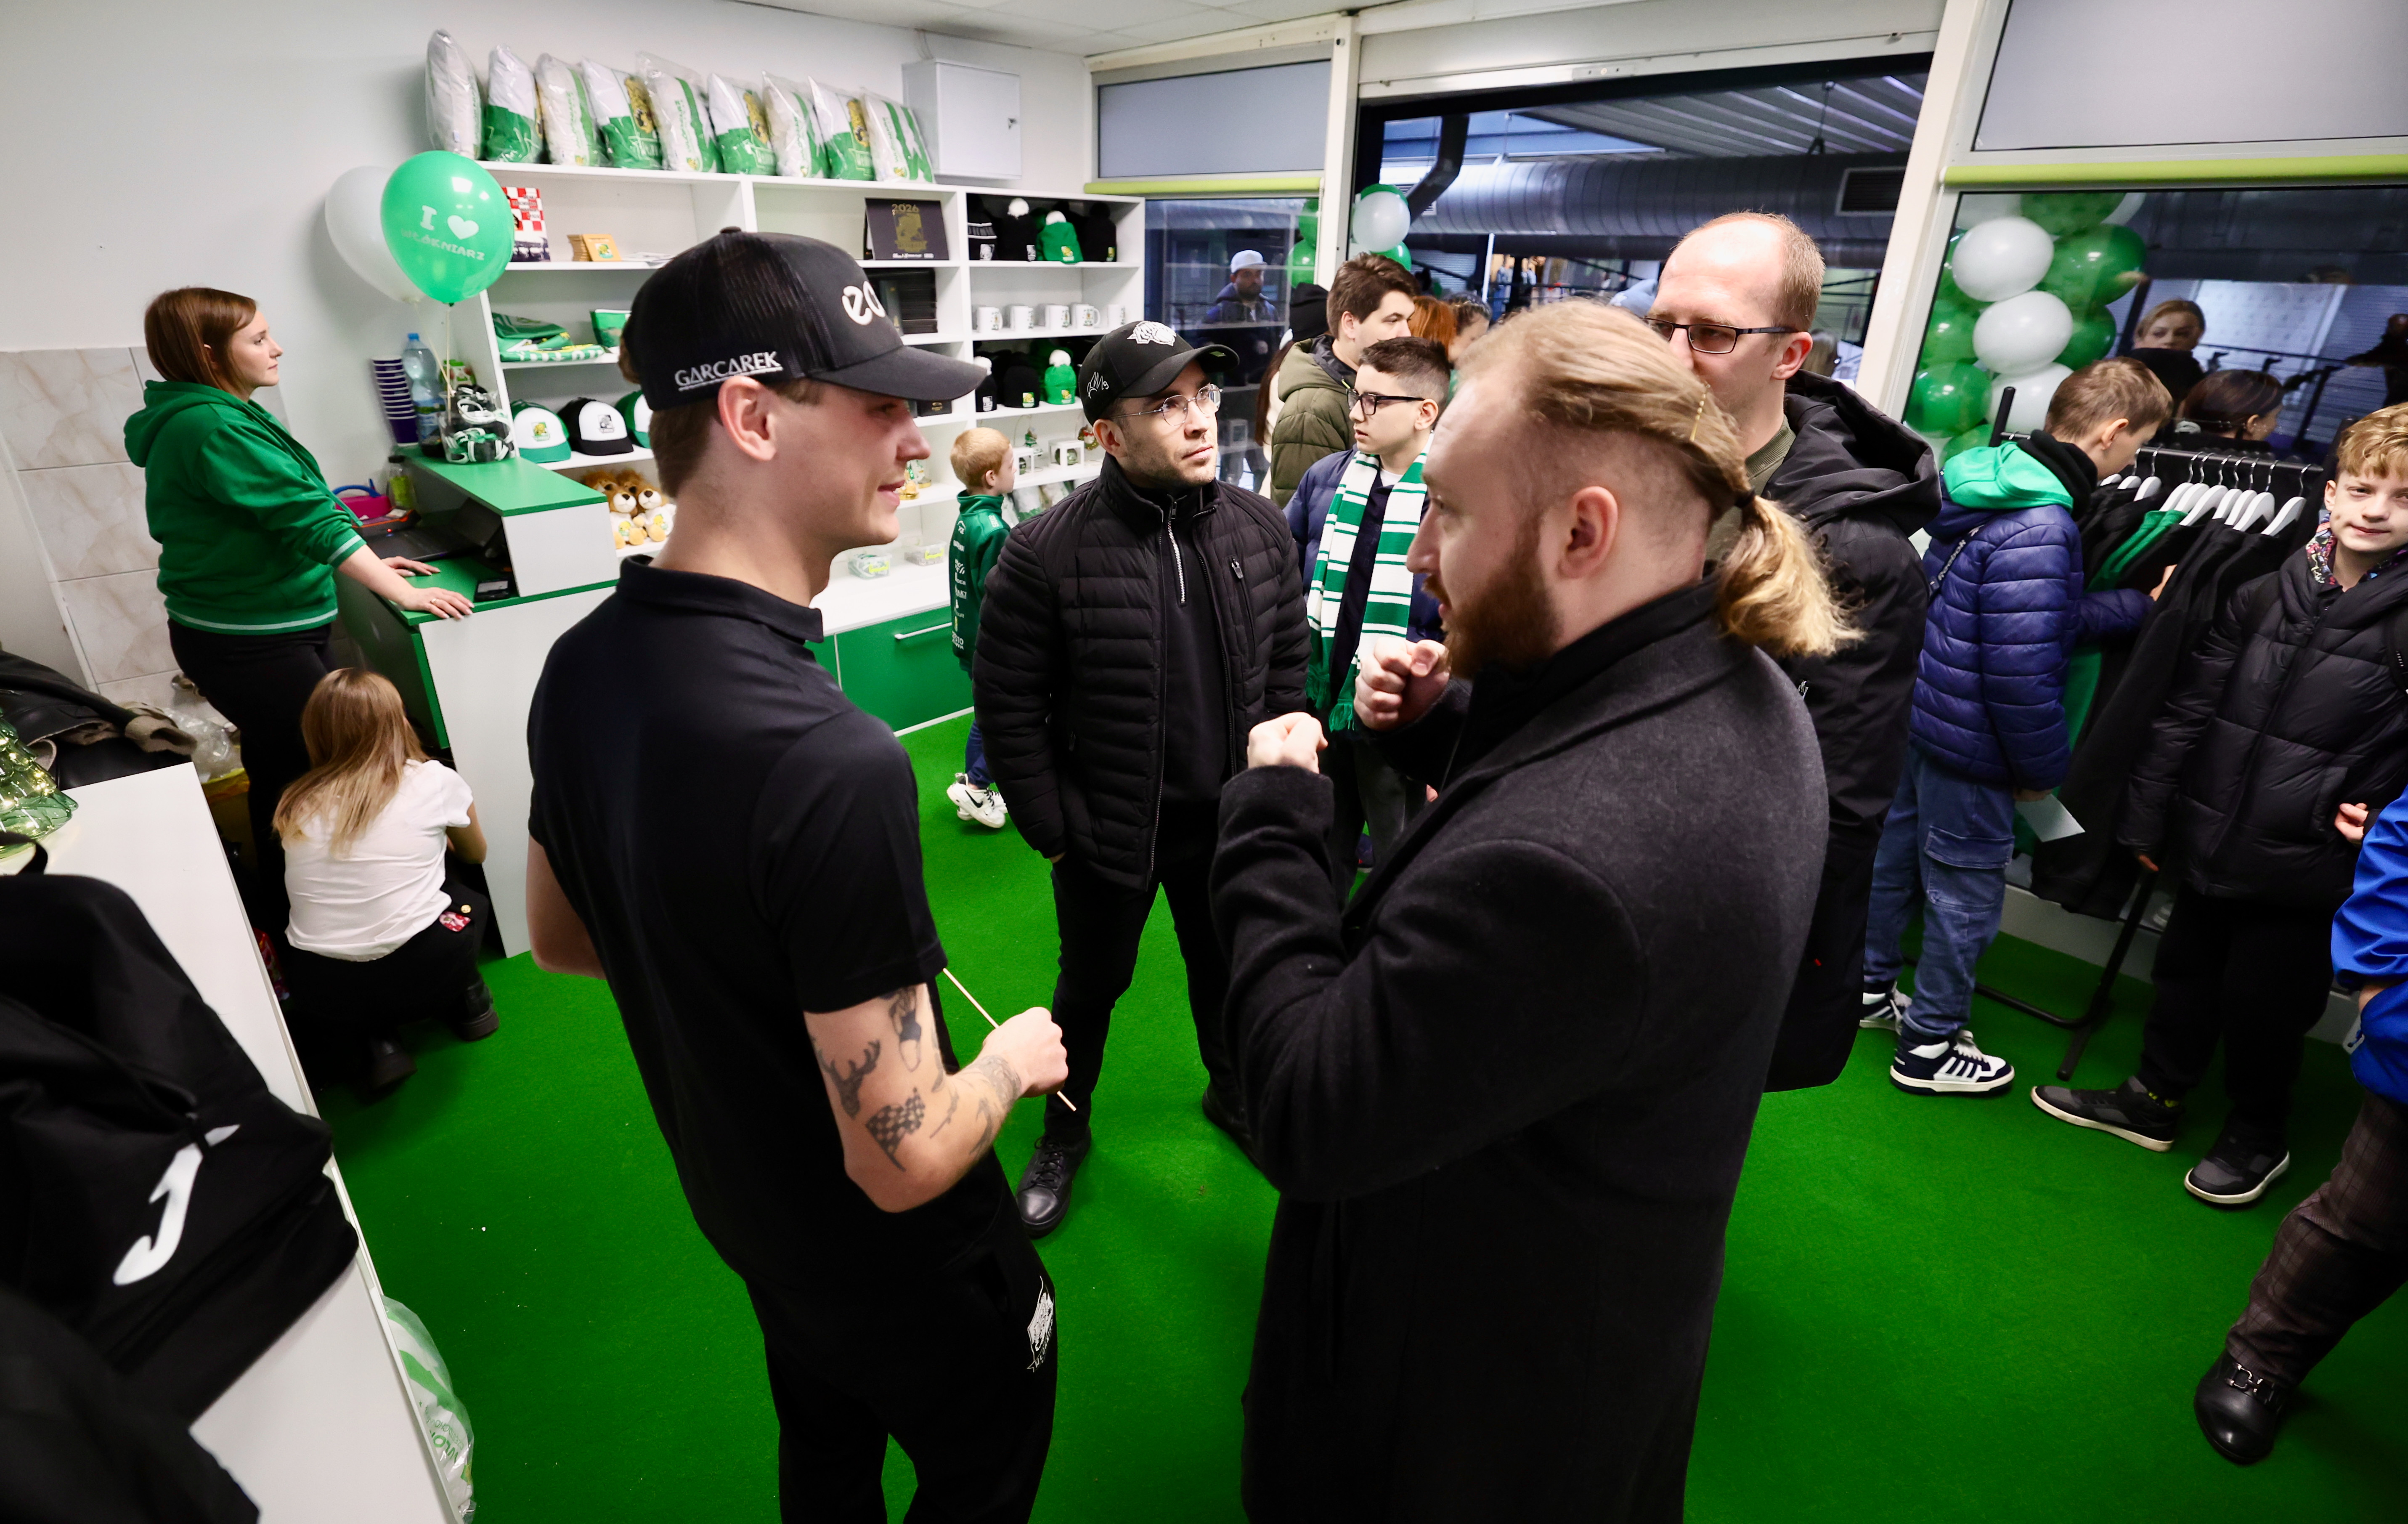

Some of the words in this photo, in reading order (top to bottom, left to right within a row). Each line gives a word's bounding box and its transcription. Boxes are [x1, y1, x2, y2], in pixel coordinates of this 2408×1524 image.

[420, 205, 437, 231] I
[892, 204, 920, 213] 2026
[674, 351, 781, 386] GARCAREK
